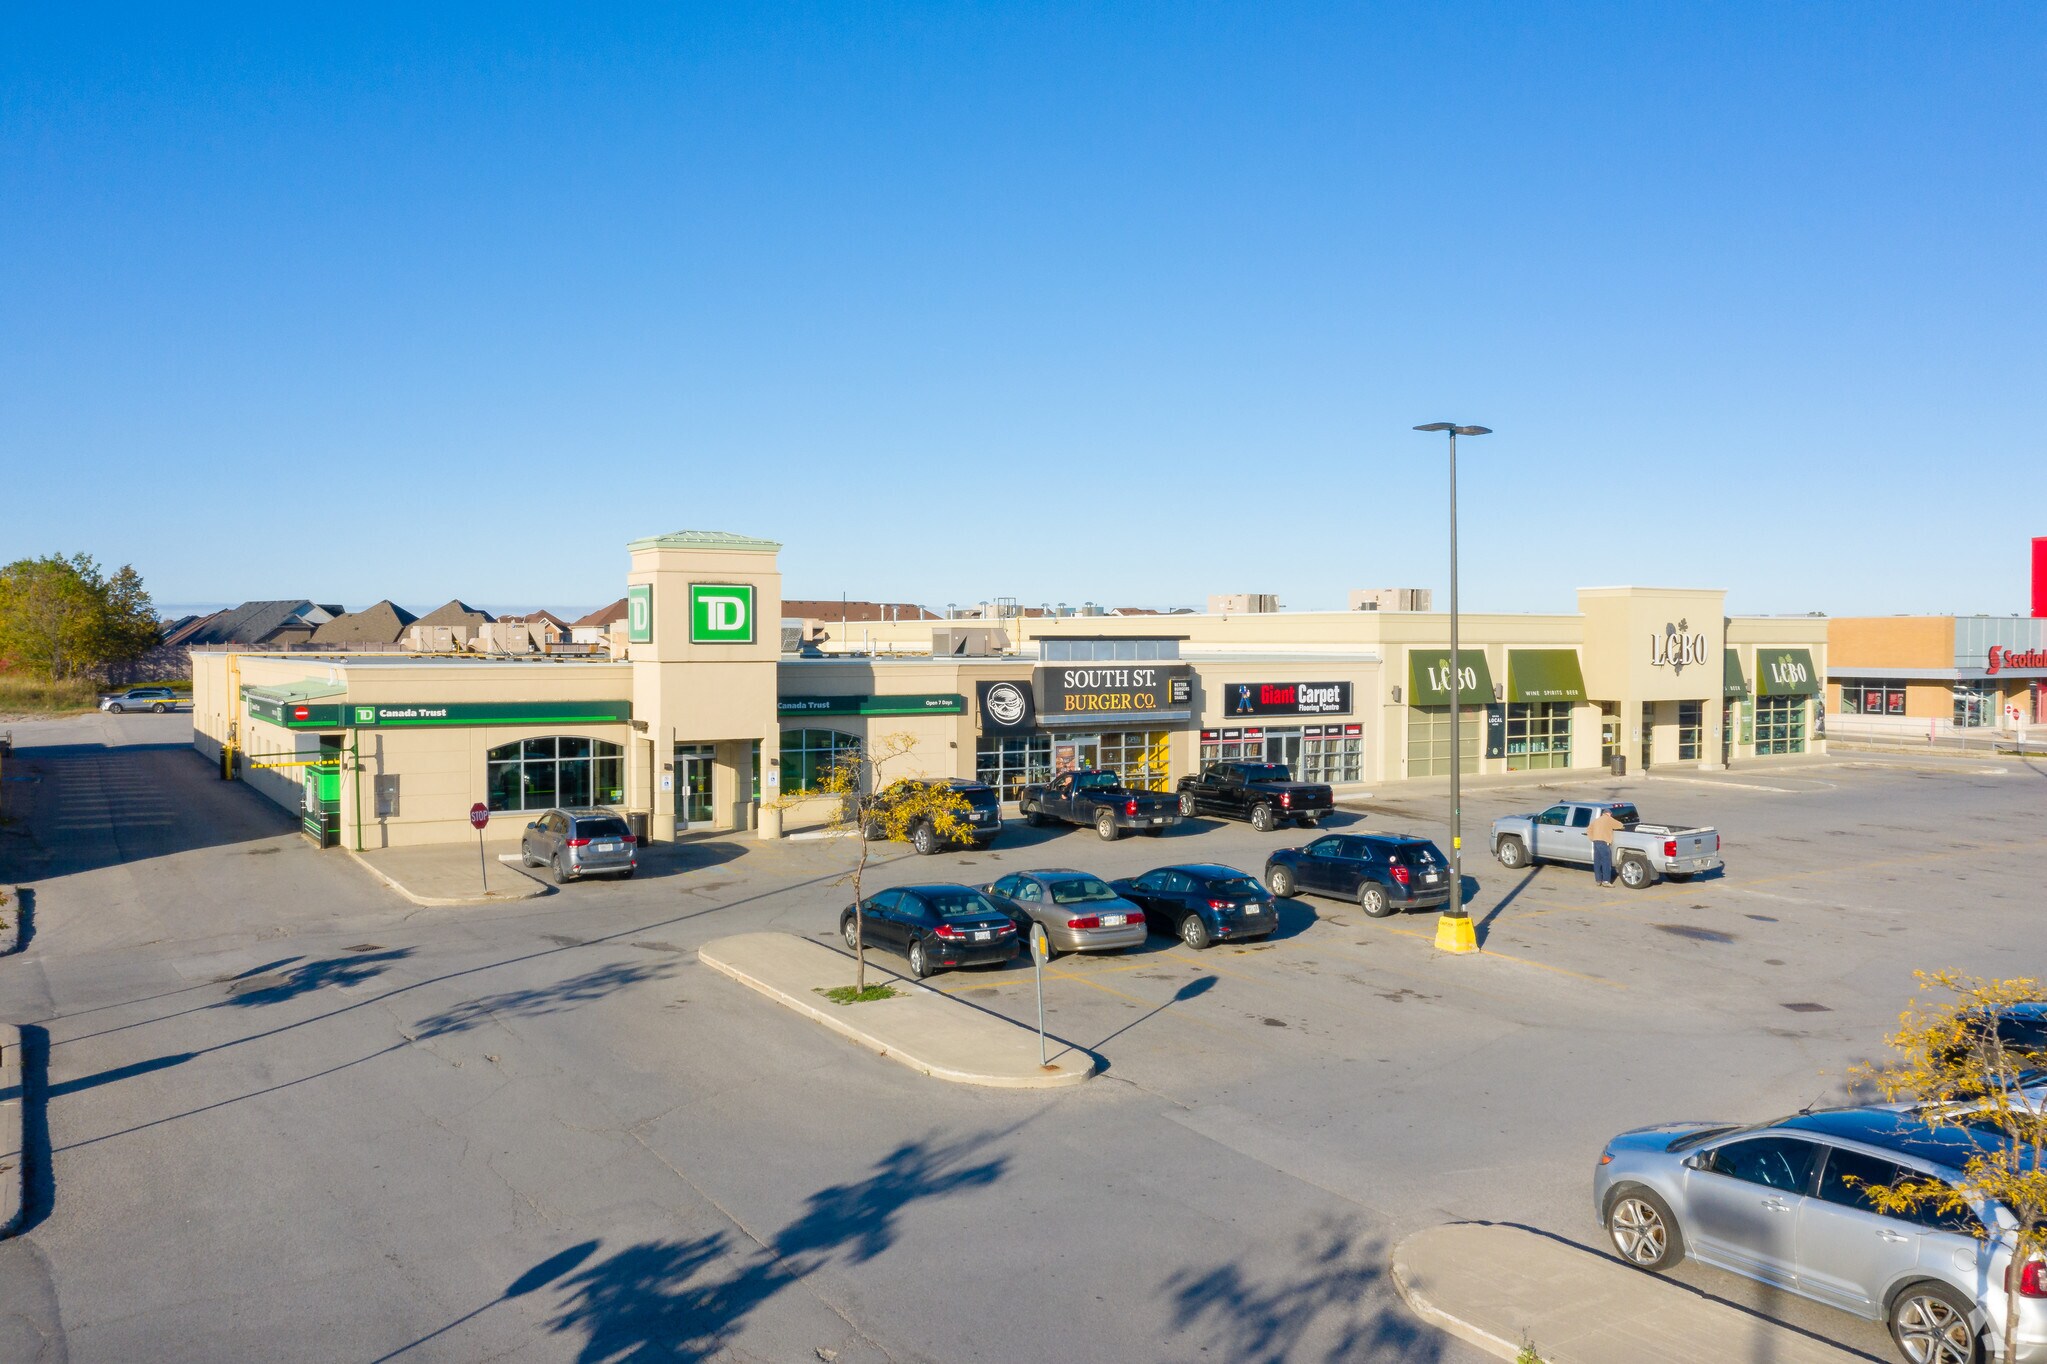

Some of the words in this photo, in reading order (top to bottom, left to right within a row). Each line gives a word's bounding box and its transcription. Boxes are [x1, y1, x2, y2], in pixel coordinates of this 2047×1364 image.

[631, 597, 648, 630] TD
[698, 596, 745, 630] TD
[1651, 633, 1708, 665] LCBO
[1064, 670, 1129, 688] SOUTH
[1133, 669, 1157, 687] ST.
[1771, 663, 1807, 683] LCBO
[1064, 693, 1132, 711] BURGER
[1261, 684, 1295, 705] Giant
[1298, 684, 1340, 707] Carpet
[419, 708, 446, 717] Trust
[808, 701, 830, 709] Trust
[1298, 704, 1320, 712] Flooring
[1322, 703, 1340, 711] Centre
[357, 709, 373, 720] TD
[471, 810, 488, 822] STOP
